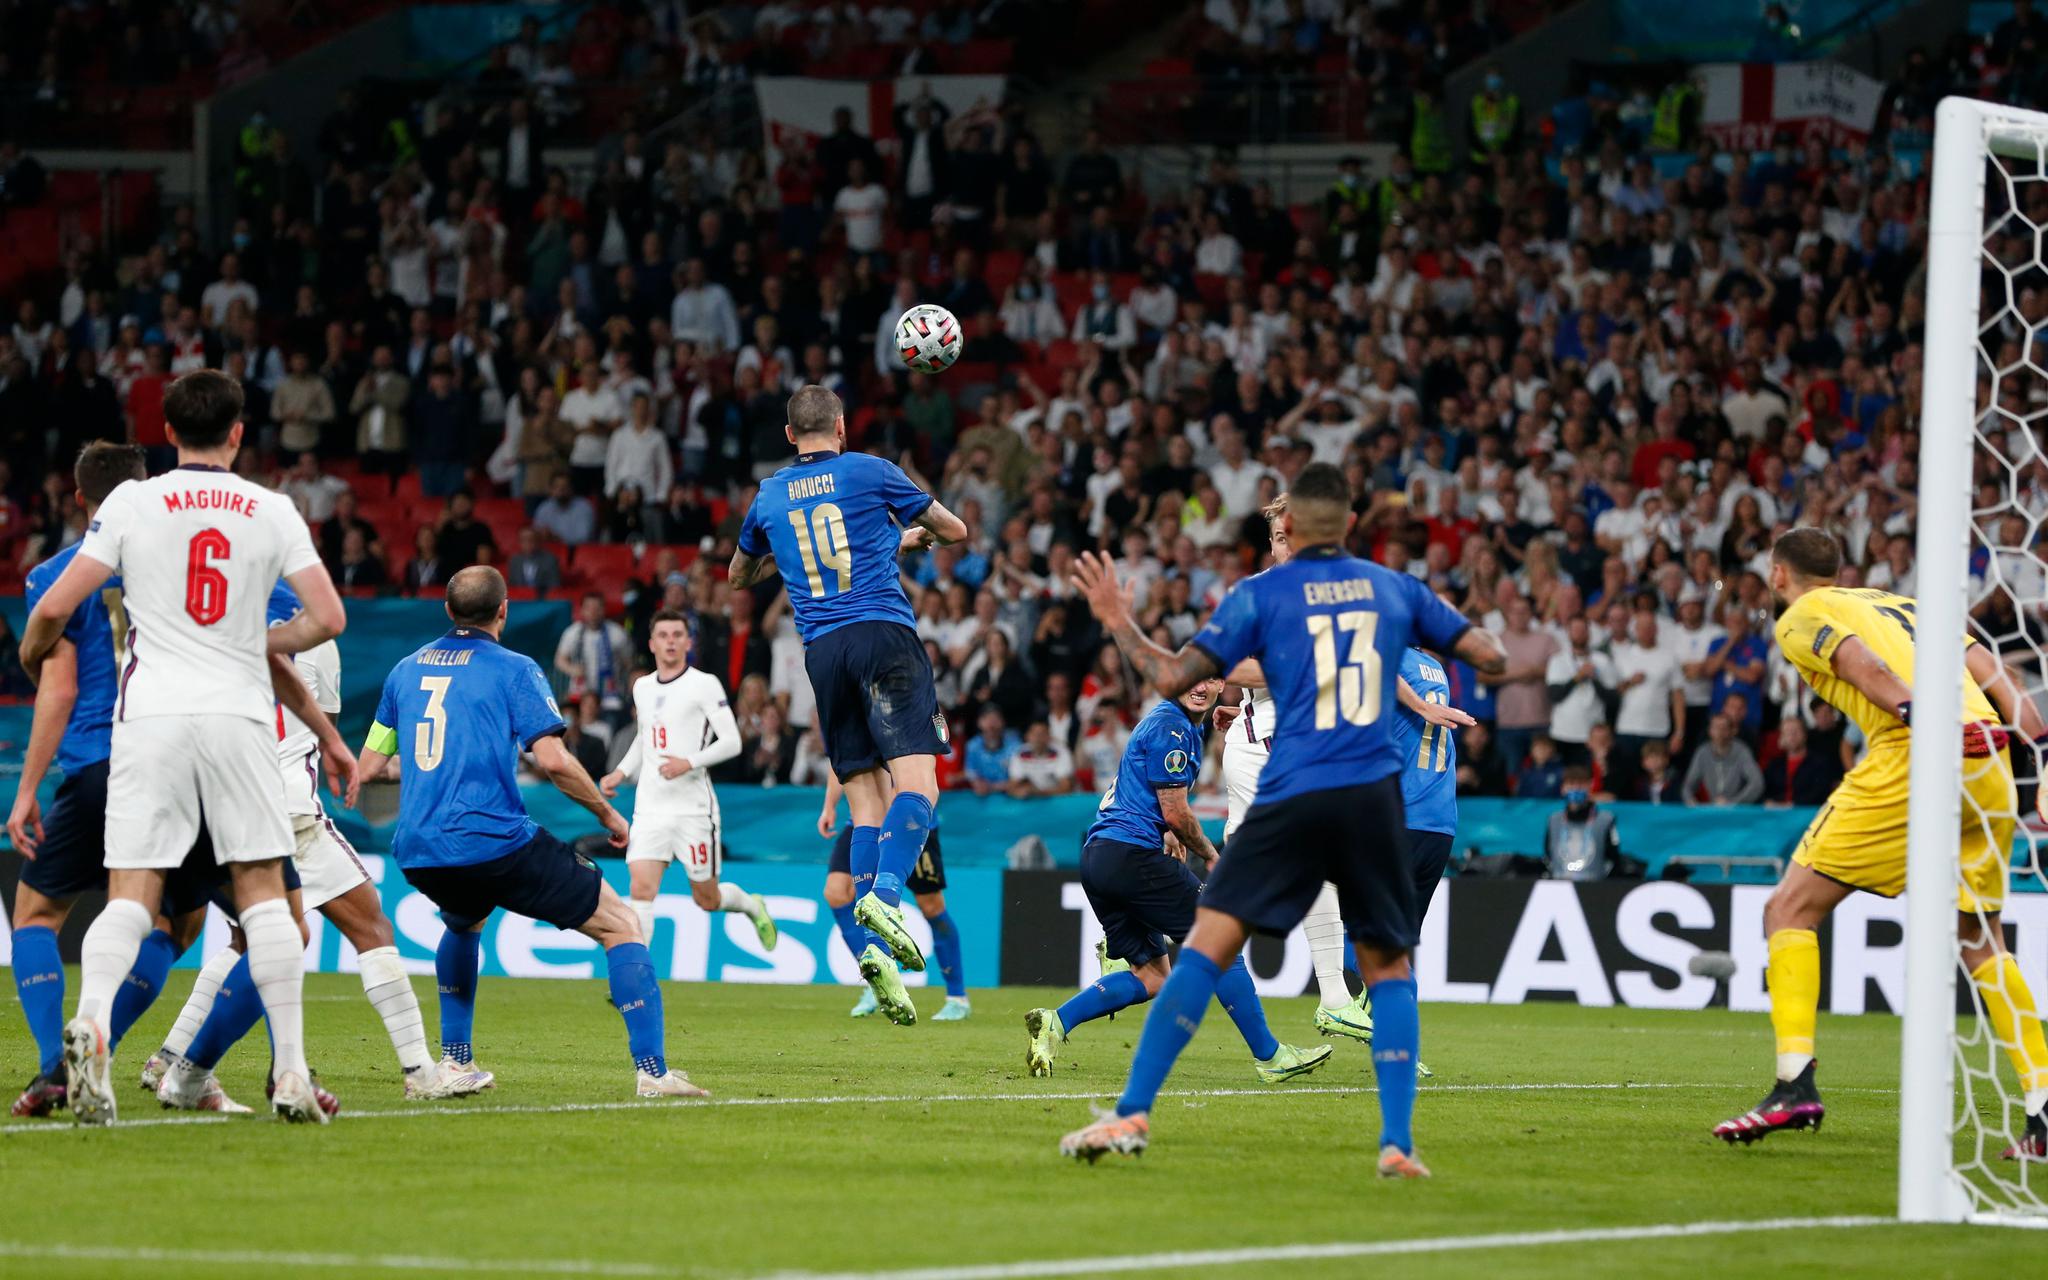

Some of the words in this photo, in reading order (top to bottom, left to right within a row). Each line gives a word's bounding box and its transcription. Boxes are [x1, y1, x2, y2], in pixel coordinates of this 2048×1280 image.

[788, 473, 835, 500] BONUCCI
[163, 489, 259, 518] MAGUIRE
[787, 503, 851, 598] 19
[184, 527, 231, 626] 6
[1304, 579, 1375, 606] EMERSON
[417, 648, 474, 666] CHIELLINI
[1306, 611, 1382, 730] 13
[414, 676, 452, 772] 3
[652, 727, 667, 749] 19
[1417, 690, 1447, 772] 11
[689, 842, 708, 865] 19
